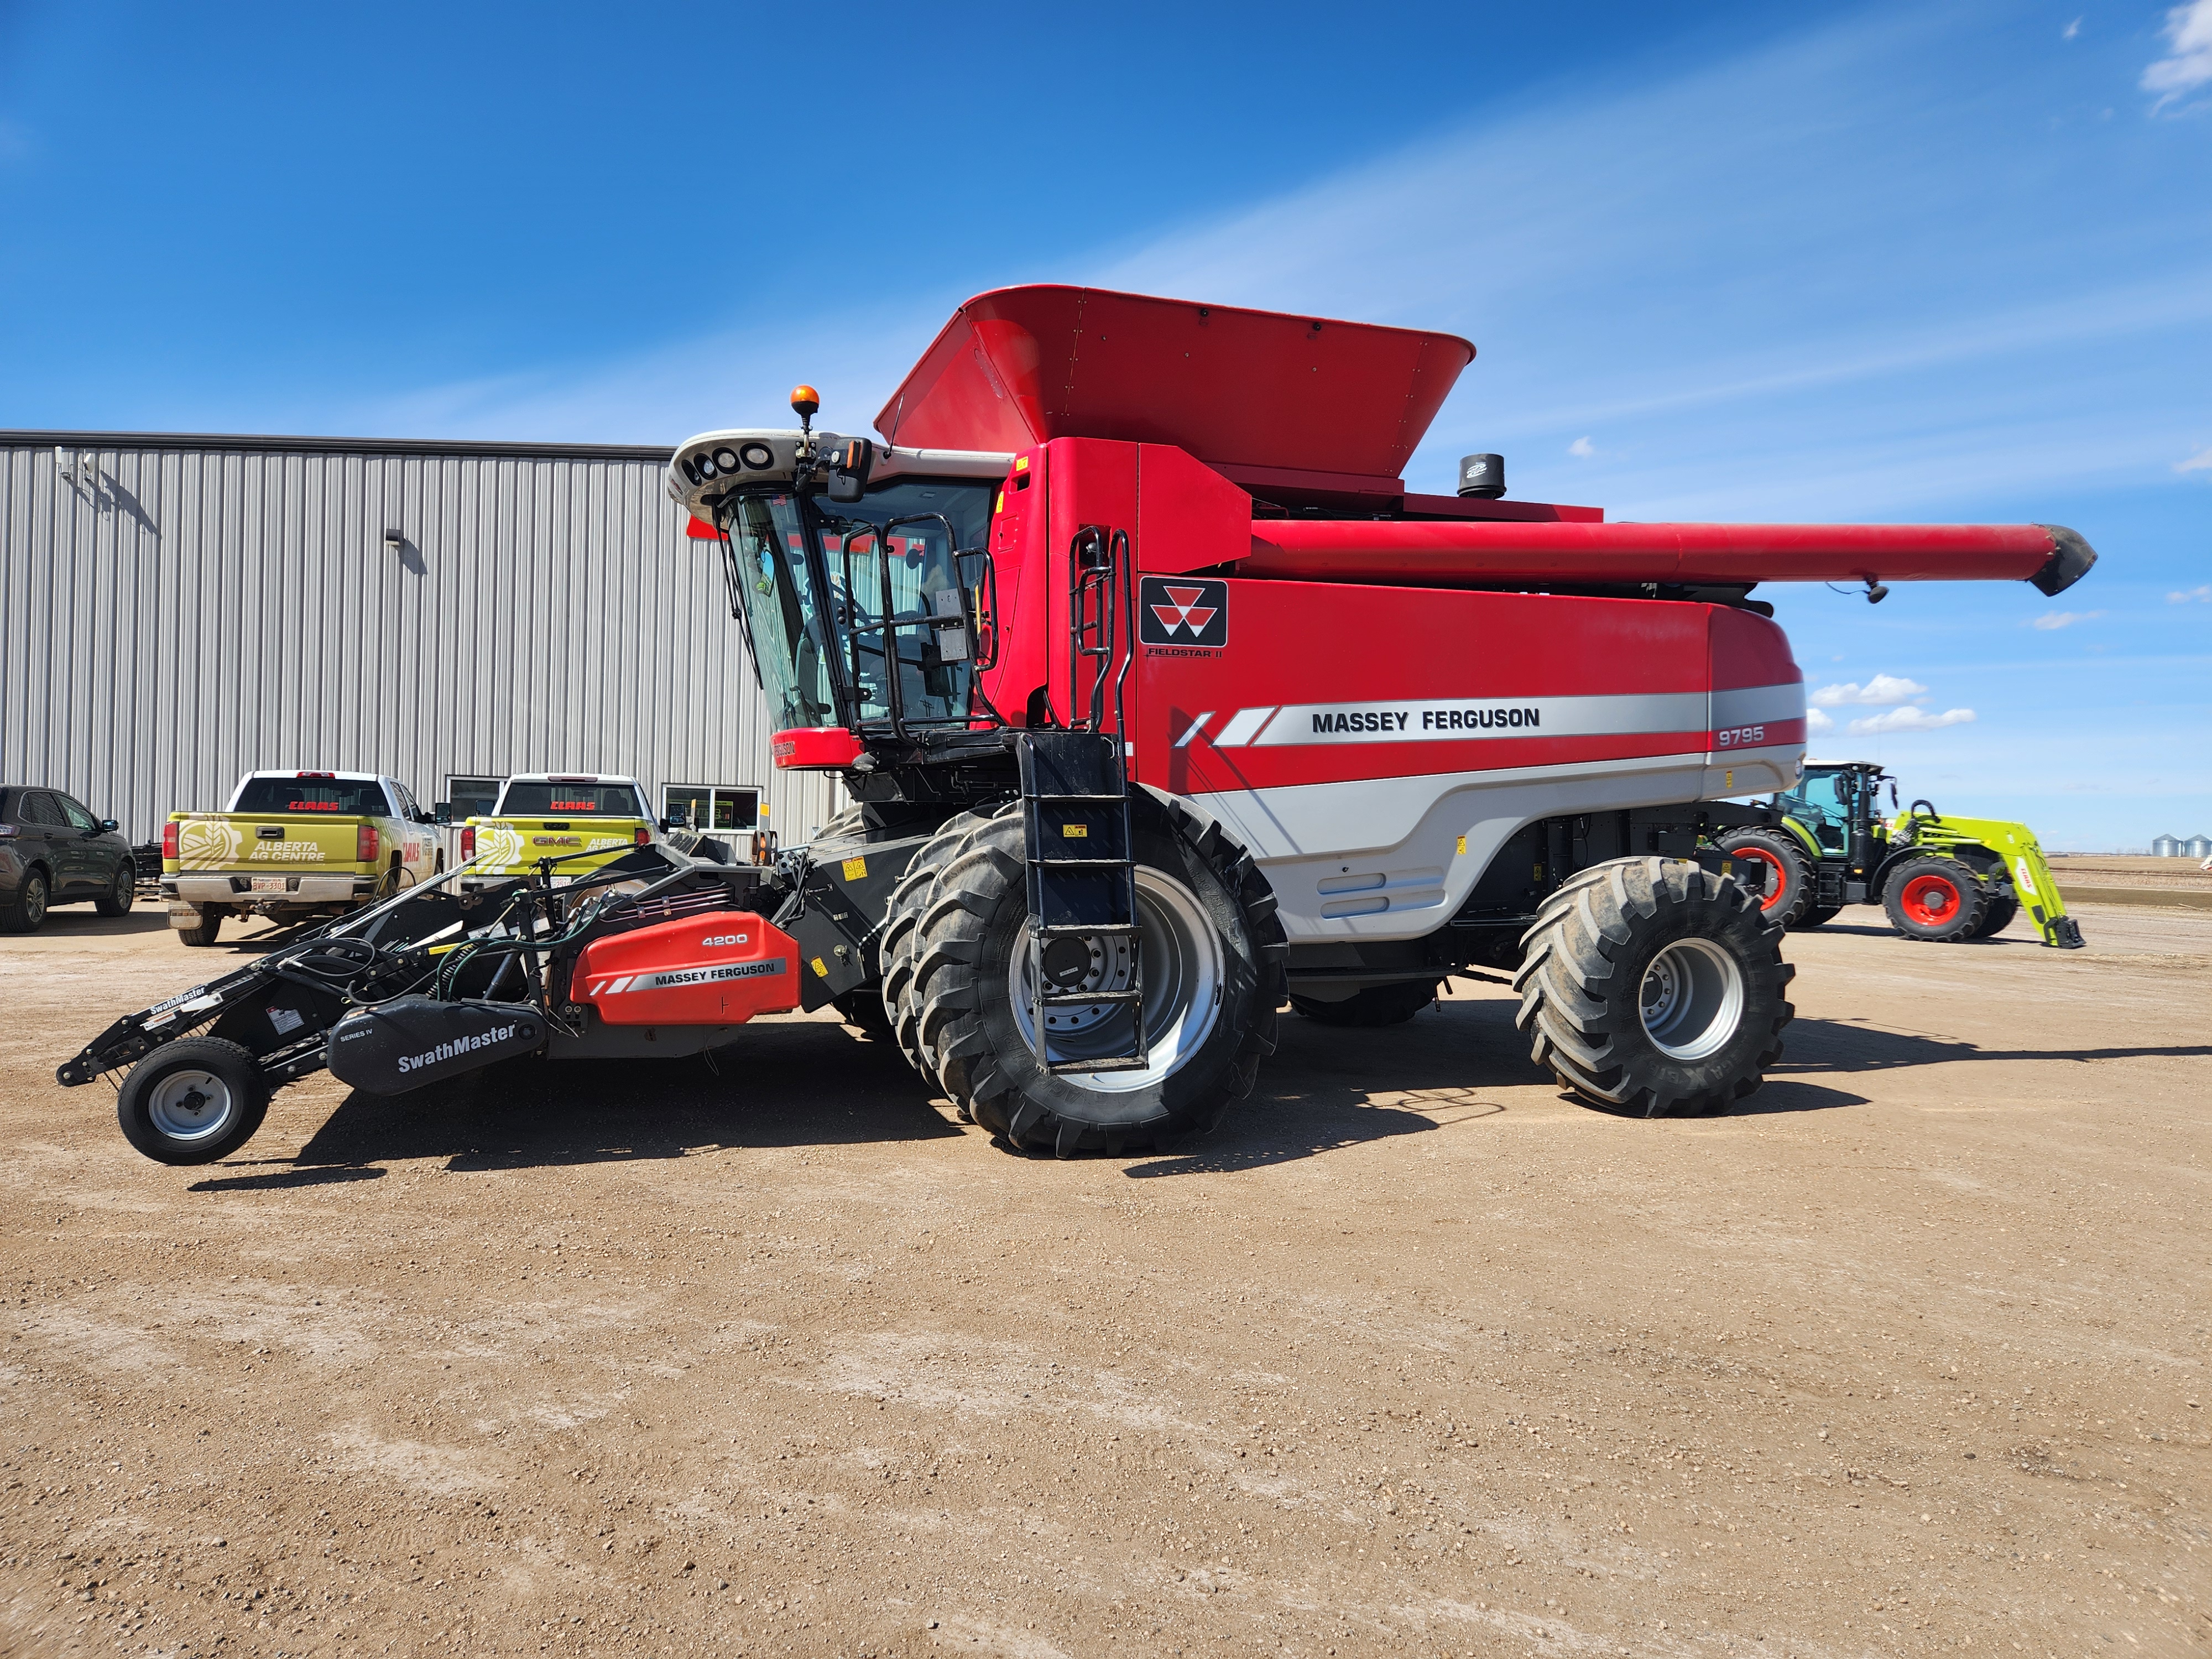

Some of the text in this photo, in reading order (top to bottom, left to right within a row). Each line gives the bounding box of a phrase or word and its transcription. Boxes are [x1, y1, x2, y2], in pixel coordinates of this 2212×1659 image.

[1148, 648, 1211, 657] FIELDSTAR
[1312, 708, 1541, 733] MASSEY FERGUSON
[1719, 726, 1764, 747] 9795
[289, 801, 339, 811] CLAAS
[550, 801, 595, 810] CLAAS
[254, 841, 318, 852] ALBERTA
[533, 836, 581, 846] GMC
[248, 852, 325, 861] AG CENTRE
[2021, 868, 2032, 888] CLAAS
[702, 934, 748, 946] 4200
[655, 963, 775, 985] MASSEY FERGUSON
[150, 987, 205, 1015] SwathMaster
[340, 1030, 366, 1042] SERIES
[398, 1024, 515, 1073] SwathMaster
